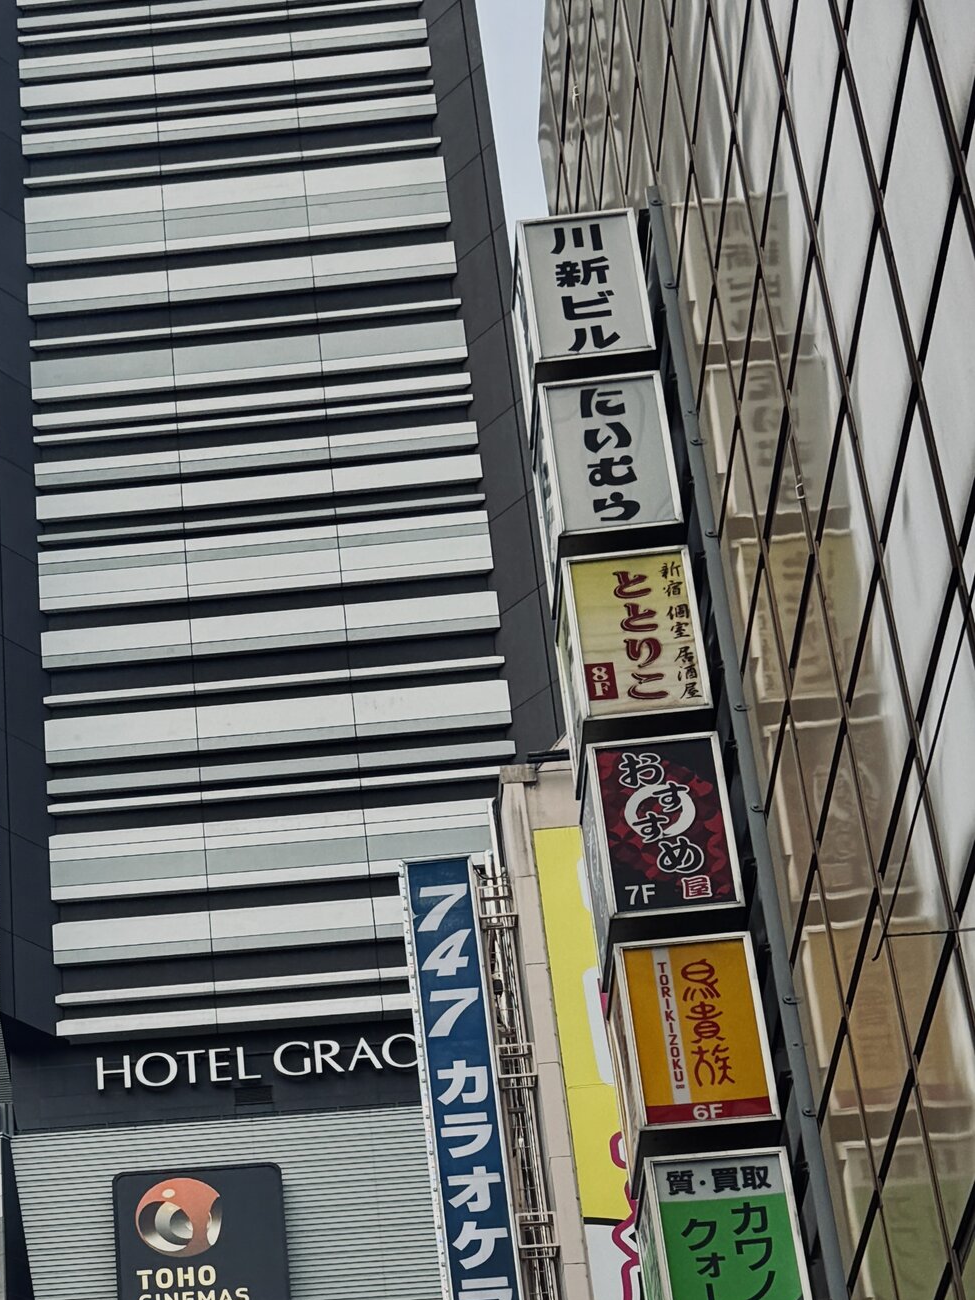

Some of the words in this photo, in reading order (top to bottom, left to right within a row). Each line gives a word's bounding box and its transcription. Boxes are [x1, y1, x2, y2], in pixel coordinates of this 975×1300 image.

[551, 223, 621, 351] 川新ビル
[580, 388, 641, 522] にいむら
[612, 570, 670, 700] ととりこ
[591, 667, 610, 697] 8F
[625, 884, 656, 905] 7F
[657, 961, 684, 1083] TORIKIZOKU
[96, 1046, 262, 1090] HOTEL
[693, 1104, 723, 1120] 6F
[136, 1265, 217, 1290] TOHO
